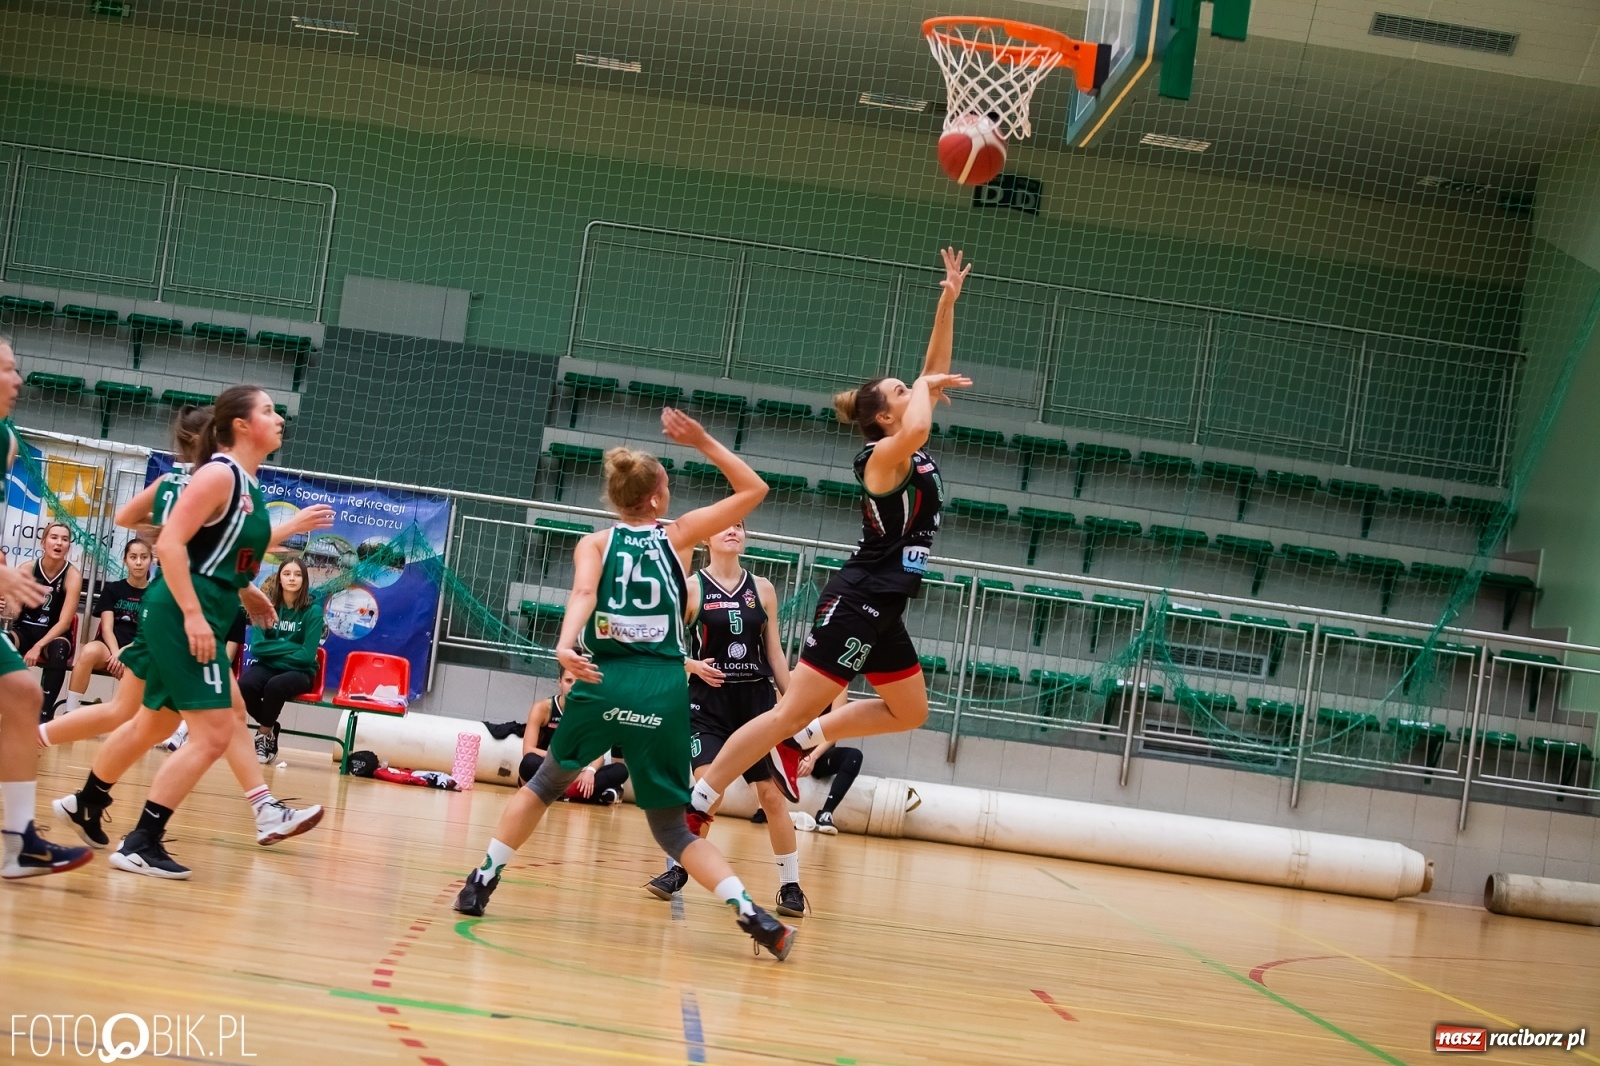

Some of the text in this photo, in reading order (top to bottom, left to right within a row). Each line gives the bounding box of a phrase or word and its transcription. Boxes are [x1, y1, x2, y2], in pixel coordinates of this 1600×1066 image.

[295, 487, 336, 504] Sportu
[339, 494, 344, 505] i
[347, 496, 406, 514] Rekreacji
[340, 511, 403, 530] Raciborzu
[607, 550, 661, 610] 35
[610, 627, 666, 639] WAGTECH
[728, 609, 743, 635] 5
[837, 637, 873, 672] 23
[203, 662, 223, 694] 4
[616, 710, 663, 726] Clavis
